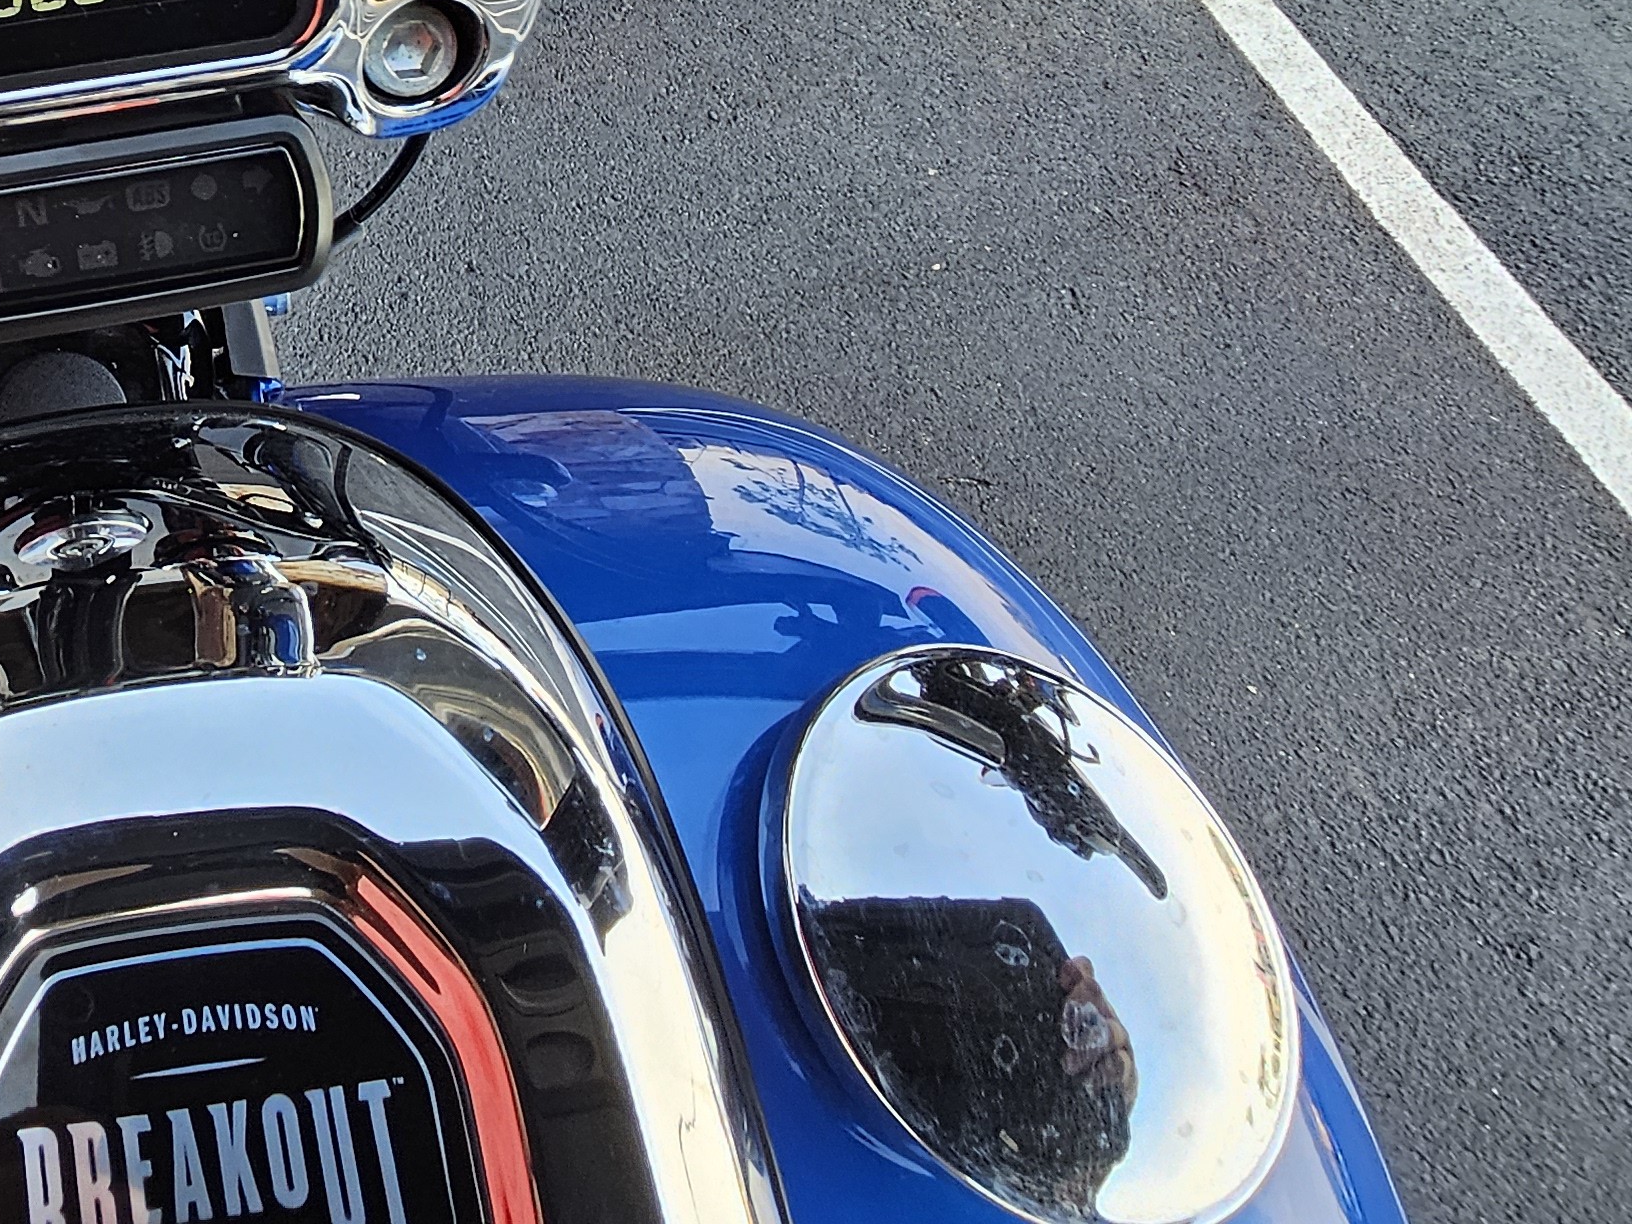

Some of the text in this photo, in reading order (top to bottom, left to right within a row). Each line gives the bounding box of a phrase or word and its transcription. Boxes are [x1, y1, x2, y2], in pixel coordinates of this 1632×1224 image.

[16, 197, 49, 228] N
[70, 1003, 319, 1066] HARLEY-DAVIDSON
[16, 1078, 408, 1224] BREAKOUT
